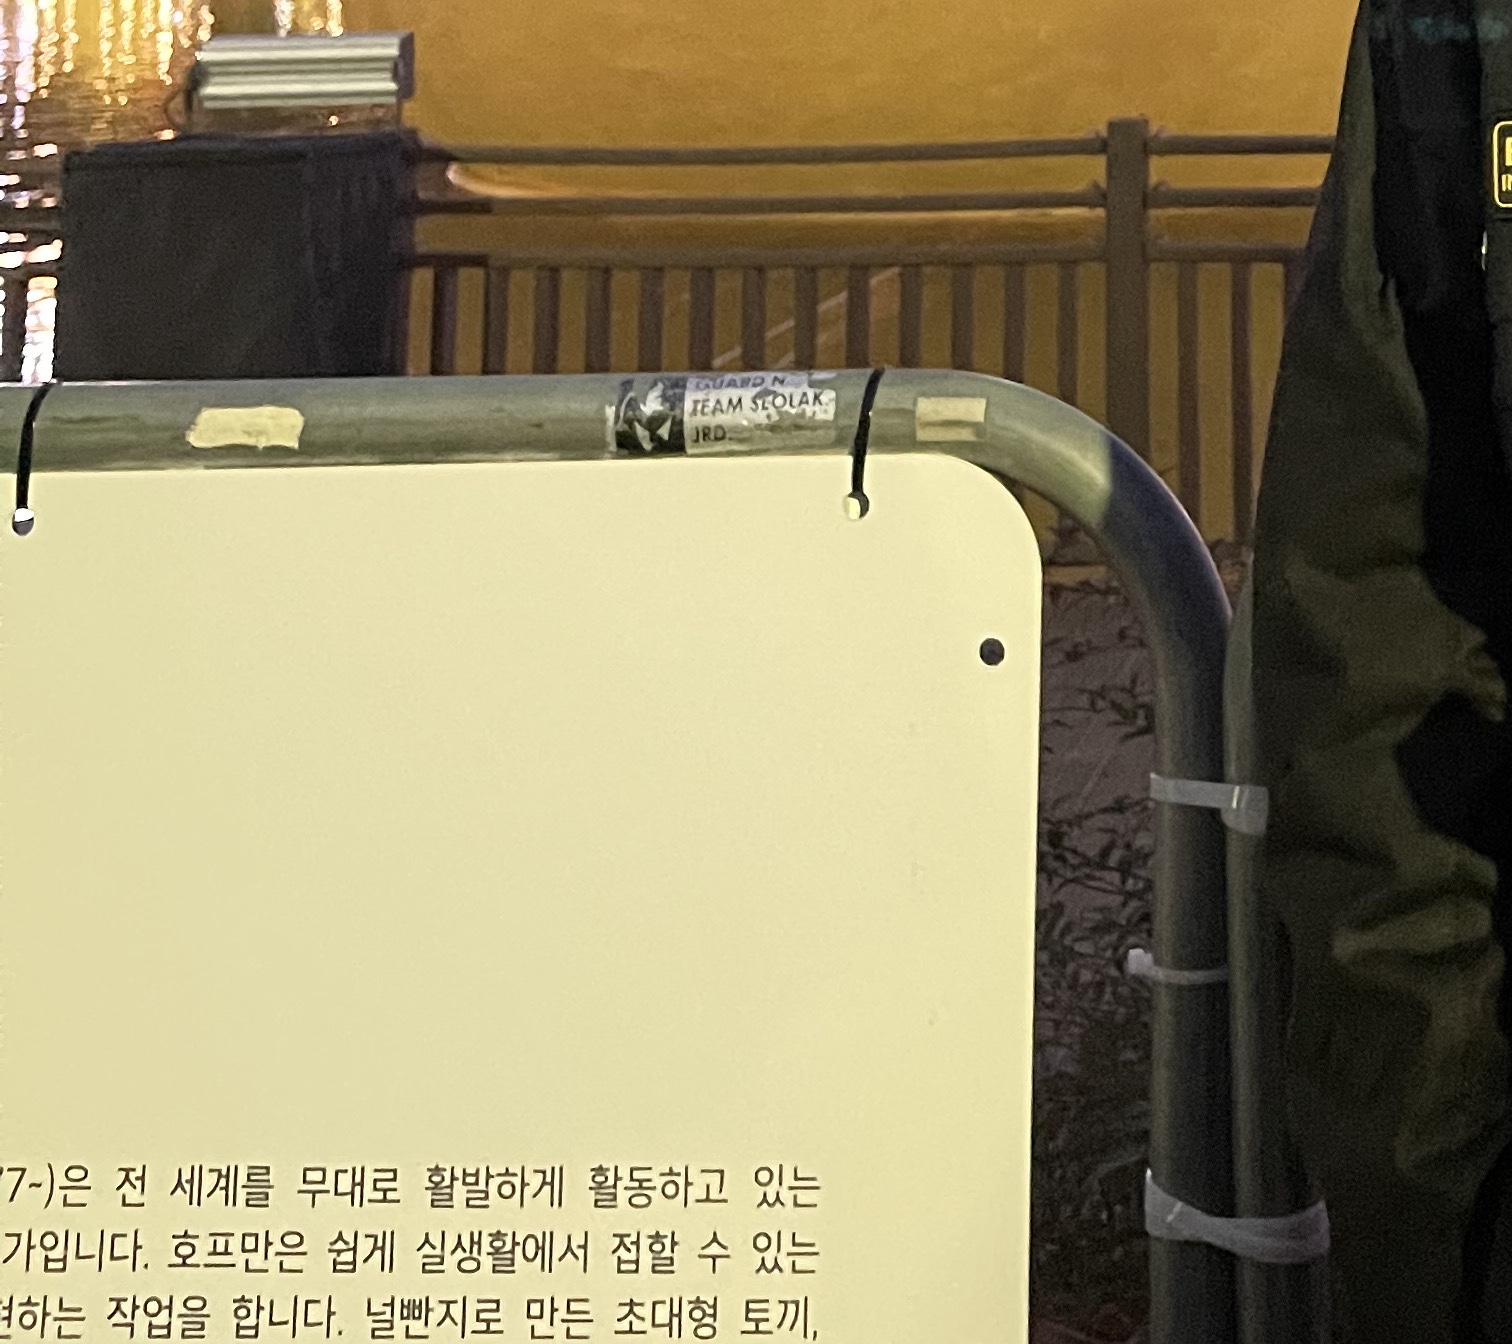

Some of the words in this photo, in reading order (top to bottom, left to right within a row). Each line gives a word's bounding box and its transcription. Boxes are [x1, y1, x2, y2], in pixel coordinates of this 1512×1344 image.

[690, 395, 744, 418] TEAM
[0, 1162, 92, 1209] 7~)은
[115, 1164, 147, 1208] 전
[169, 1164, 275, 1209] 세계를
[296, 1165, 402, 1209] 무대로
[424, 1164, 565, 1209] 활발하게
[588, 1164, 729, 1209] 활동하고
[754, 1163, 821, 1208] 있는
[2, 1228, 149, 1274] 가입니다.
[167, 1229, 309, 1274] 호프만은
[327, 1229, 395, 1274] 쉽게
[416, 1229, 589, 1275] 실생활에서
[611, 1230, 679, 1275] 접할
[697, 1230, 731, 1275] 수
[752, 1229, 820, 1274] 있는
[106, 1294, 211, 1340] 작업을
[232, 1294, 343, 1340] 합니다.
[366, 1294, 504, 1340] 널빤지로
[526, 1295, 594, 1340] 만든
[614, 1295, 718, 1340] 초대형
[740, 1295, 818, 1341] 토끼,
